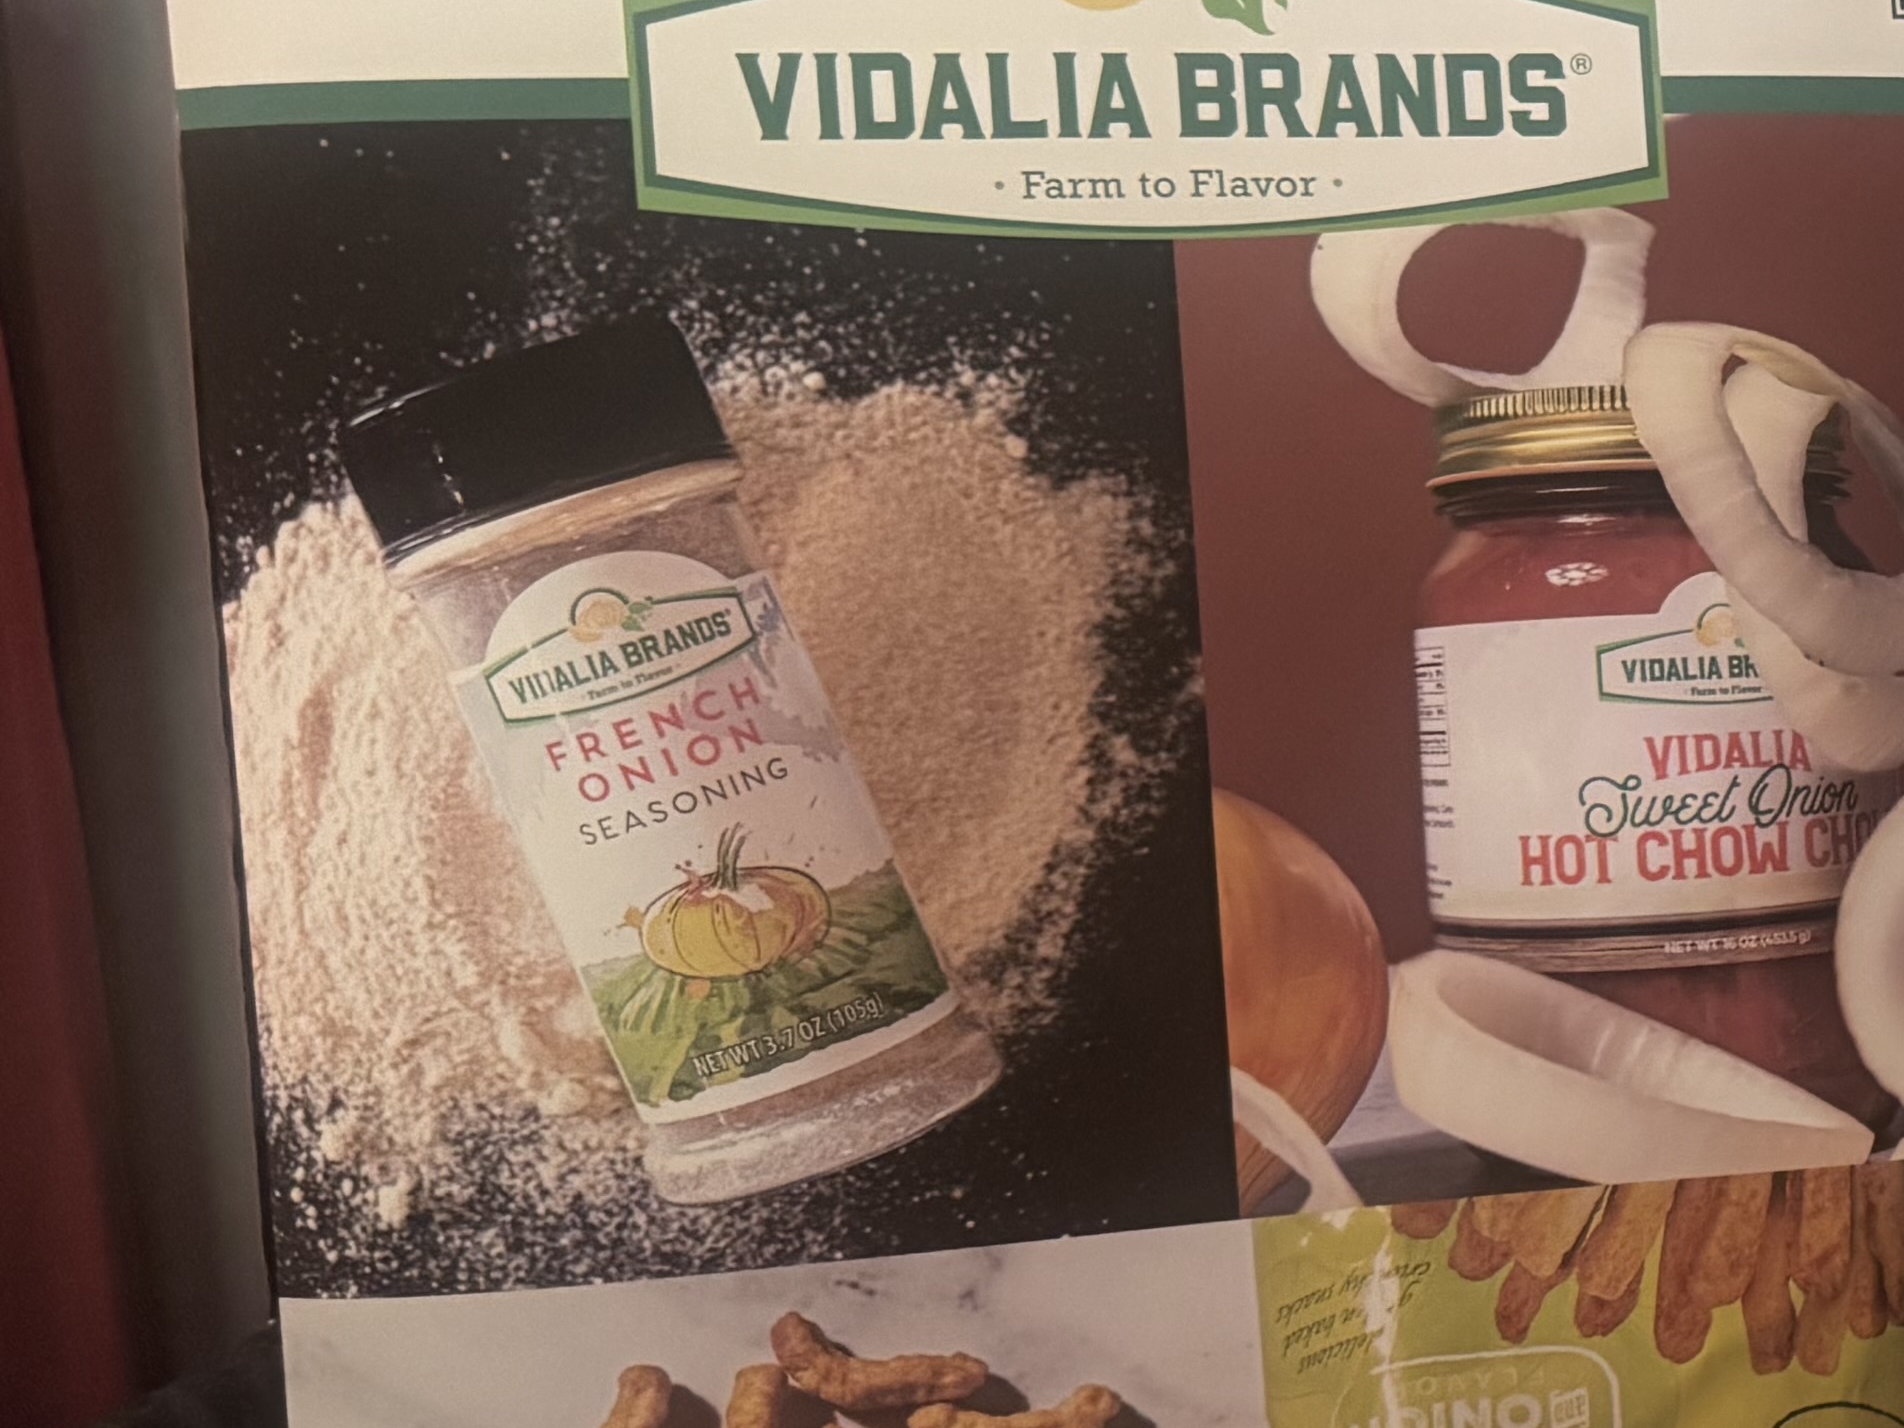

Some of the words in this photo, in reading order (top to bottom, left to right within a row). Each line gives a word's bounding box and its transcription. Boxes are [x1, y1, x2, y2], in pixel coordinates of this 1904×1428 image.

[736, 51, 1151, 142] VIDALIA
[1021, 169, 1127, 202] Farm
[1139, 170, 1176, 200] to
[1189, 167, 1316, 201] Flavor
[1621, 656, 1722, 683] VIDALIA
[545, 676, 760, 772] FRENCH
[1644, 729, 1813, 781] VIDALIA
[578, 718, 764, 802] ONION
[579, 757, 788, 846] SEASONING
[1579, 774, 1739, 837] Sweet
[1748, 763, 1858, 828] Onion
[1519, 834, 1618, 887] HOT
[1636, 822, 1790, 882] CHOW
[694, 1051, 730, 1076] NET
[730, 1039, 762, 1065] WT
[763, 1028, 794, 1055] 3.7
[799, 1016, 826, 1041] OZ
